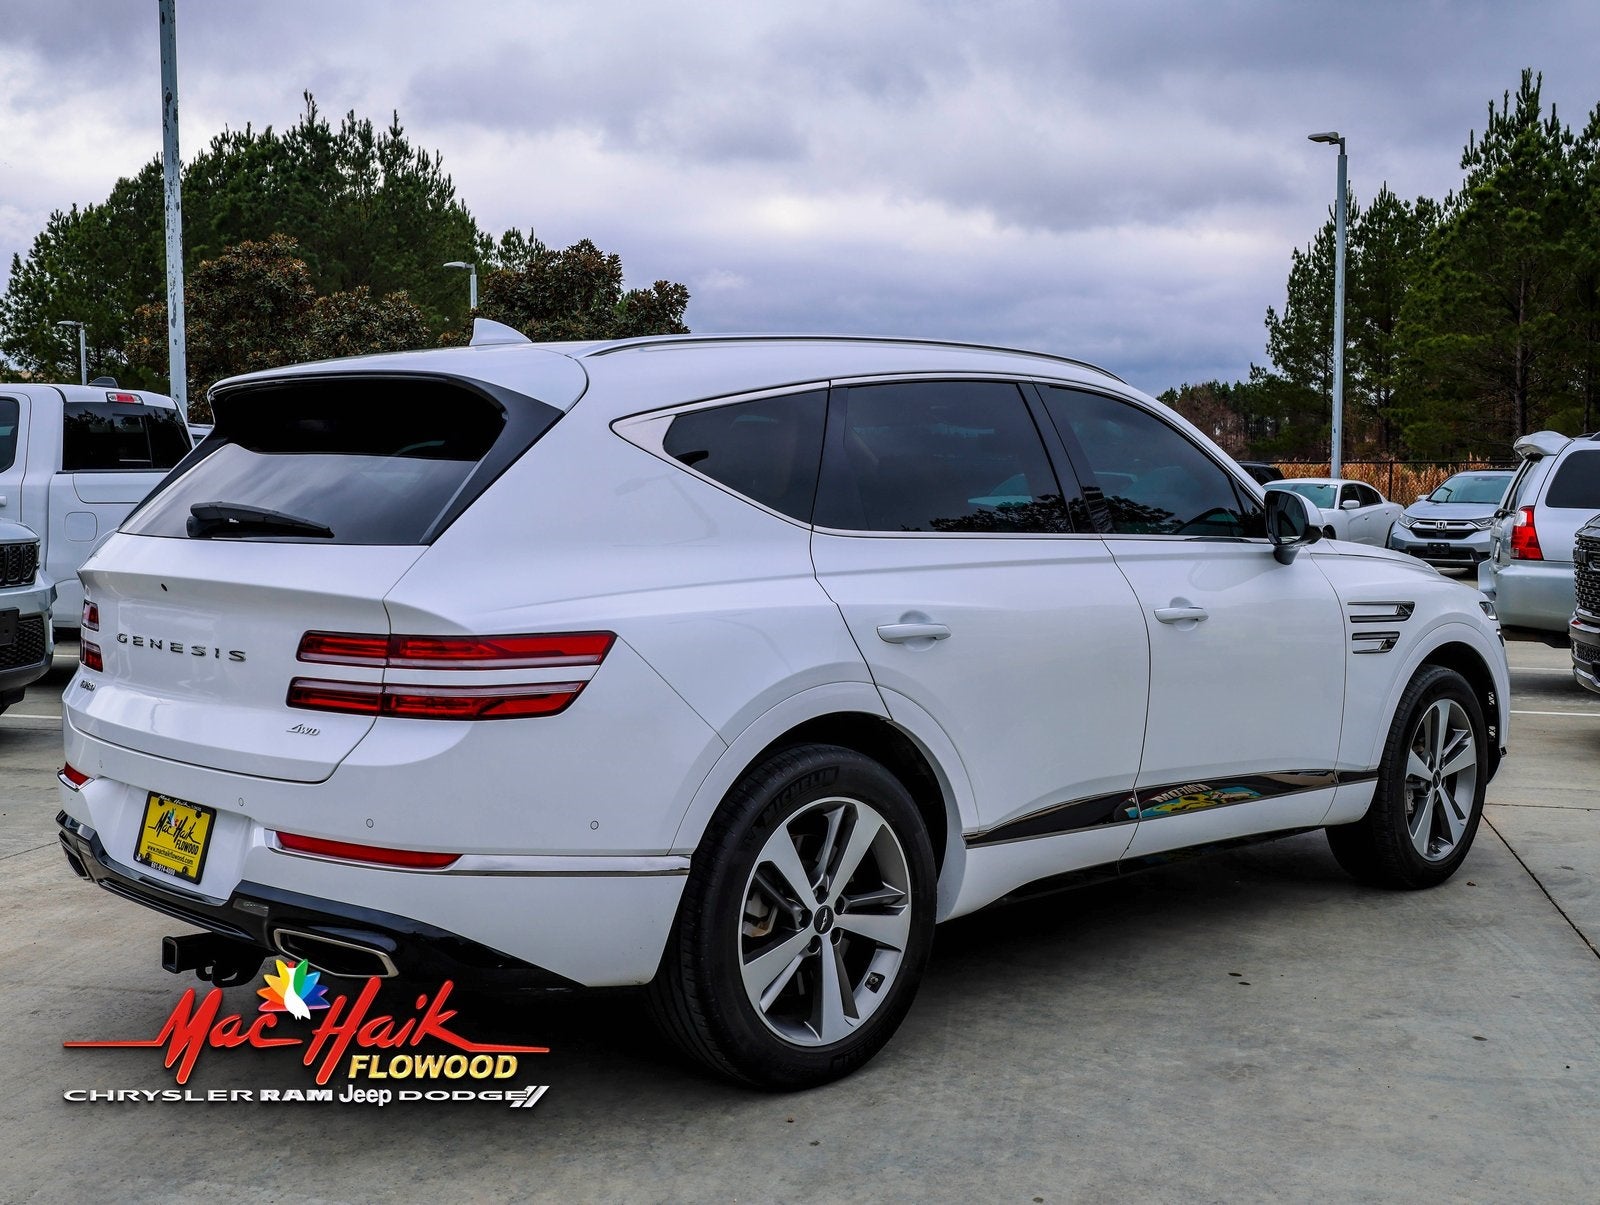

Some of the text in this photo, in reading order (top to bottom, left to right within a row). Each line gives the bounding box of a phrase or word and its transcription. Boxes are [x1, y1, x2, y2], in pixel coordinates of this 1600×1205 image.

[116, 633, 247, 662] GENESIS
[286, 723, 321, 737] 4WD
[148, 809, 201, 848] Mac Haik
[175, 839, 200, 855] FLOWOOD
